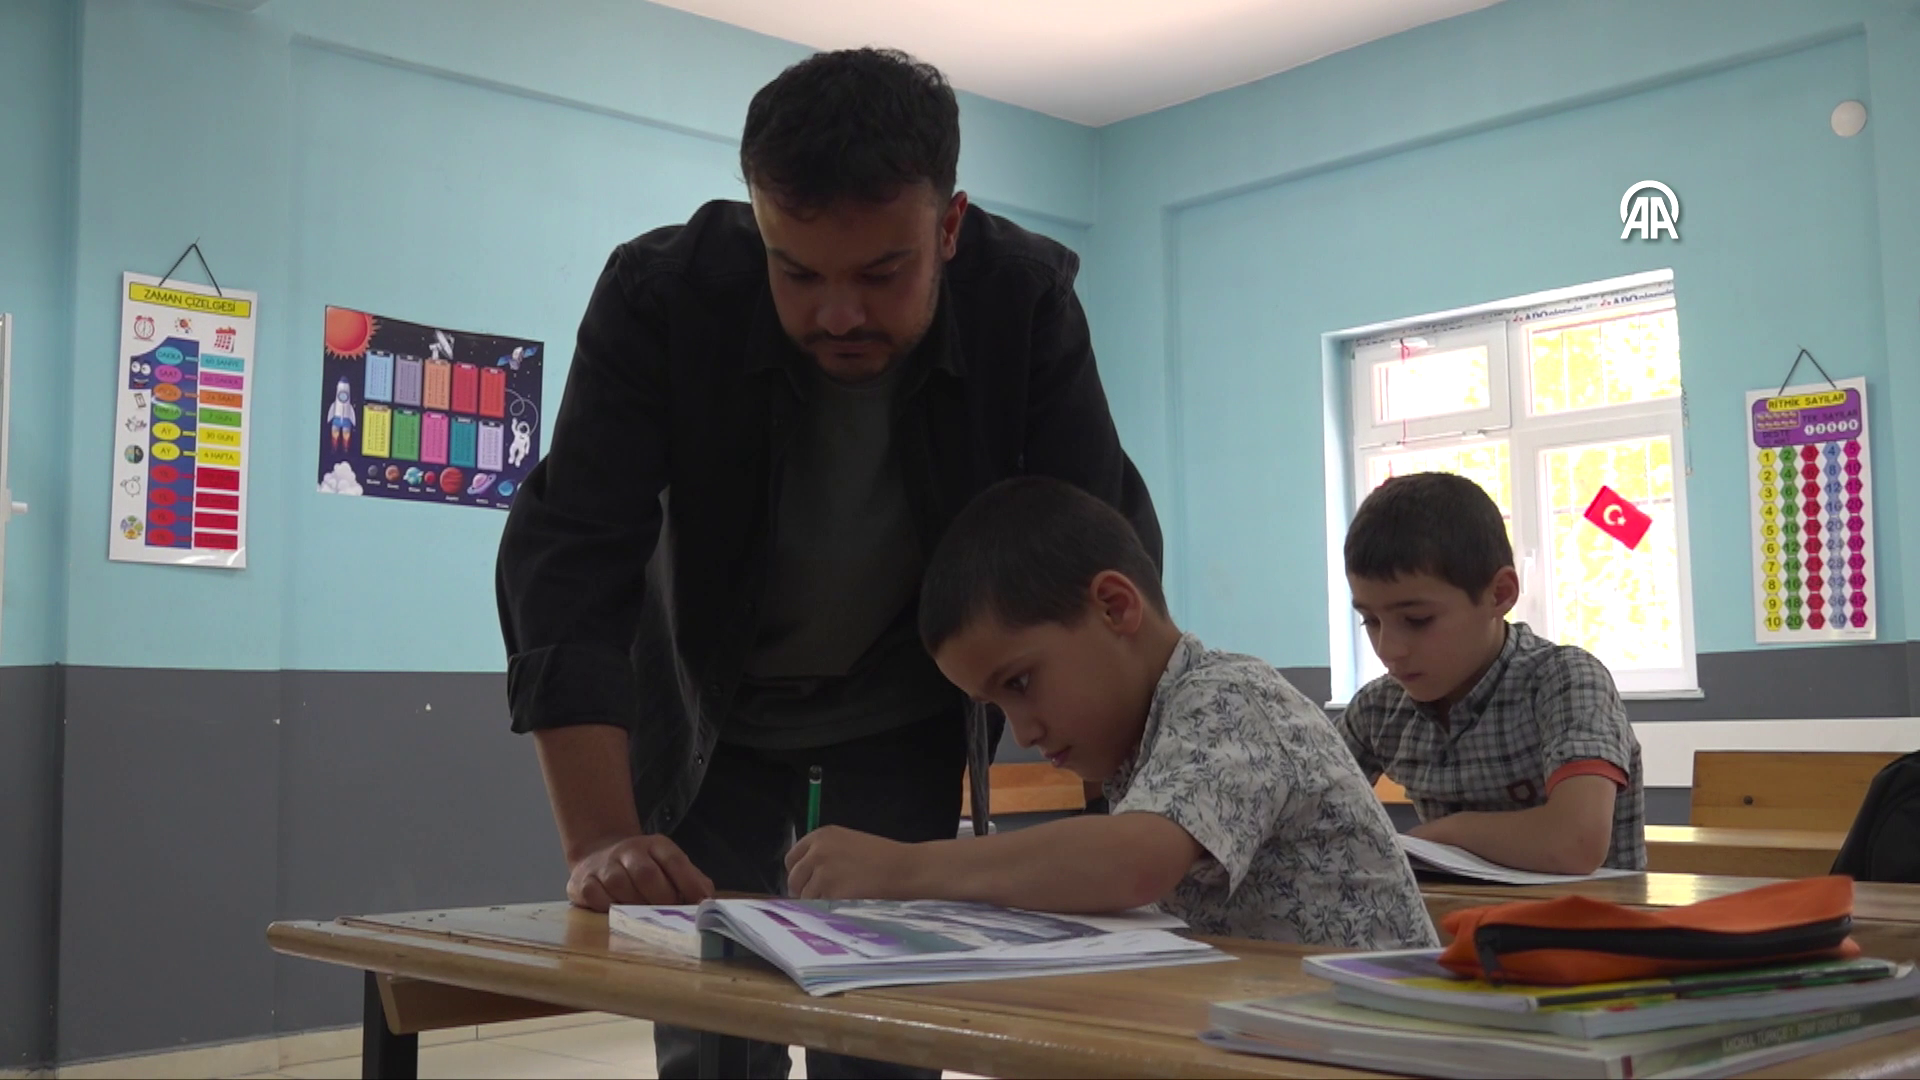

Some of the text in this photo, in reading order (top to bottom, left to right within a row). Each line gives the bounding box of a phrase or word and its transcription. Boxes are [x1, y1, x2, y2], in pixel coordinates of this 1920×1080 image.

[144, 288, 236, 312] ZAMAN ÇİZELGESİ
[1768, 393, 1845, 409] RİTMİK SAYILAR
[1803, 409, 1858, 422] TEK SAYILAR
[160, 427, 172, 435] AY
[160, 447, 171, 455] AY
[1764, 452, 1770, 462] 1
[1783, 450, 1791, 460] 2
[1828, 446, 1836, 456] 4
[1764, 471, 1771, 481] 2
[1784, 470, 1792, 479] 4
[1829, 465, 1836, 475] 8
[1846, 463, 1860, 474] 10
[1765, 488, 1772, 498] 3
[1785, 486, 1792, 496] 6
[1827, 482, 1841, 493] 12
[1765, 506, 1773, 516] 4
[1828, 501, 1842, 512] 16
[1766, 525, 1774, 536] 5
[1784, 524, 1798, 534] 10
[1827, 521, 1842, 532] 20
[1767, 543, 1774, 553] 6
[1784, 542, 1798, 552] 12
[1767, 562, 1775, 572] 7
[1785, 560, 1799, 570] 14
[1768, 580, 1776, 590] 8
[1769, 598, 1776, 609] 9
[1786, 597, 1801, 607] 18
[1767, 617, 1781, 627] 10
[1787, 616, 1801, 626] 20
